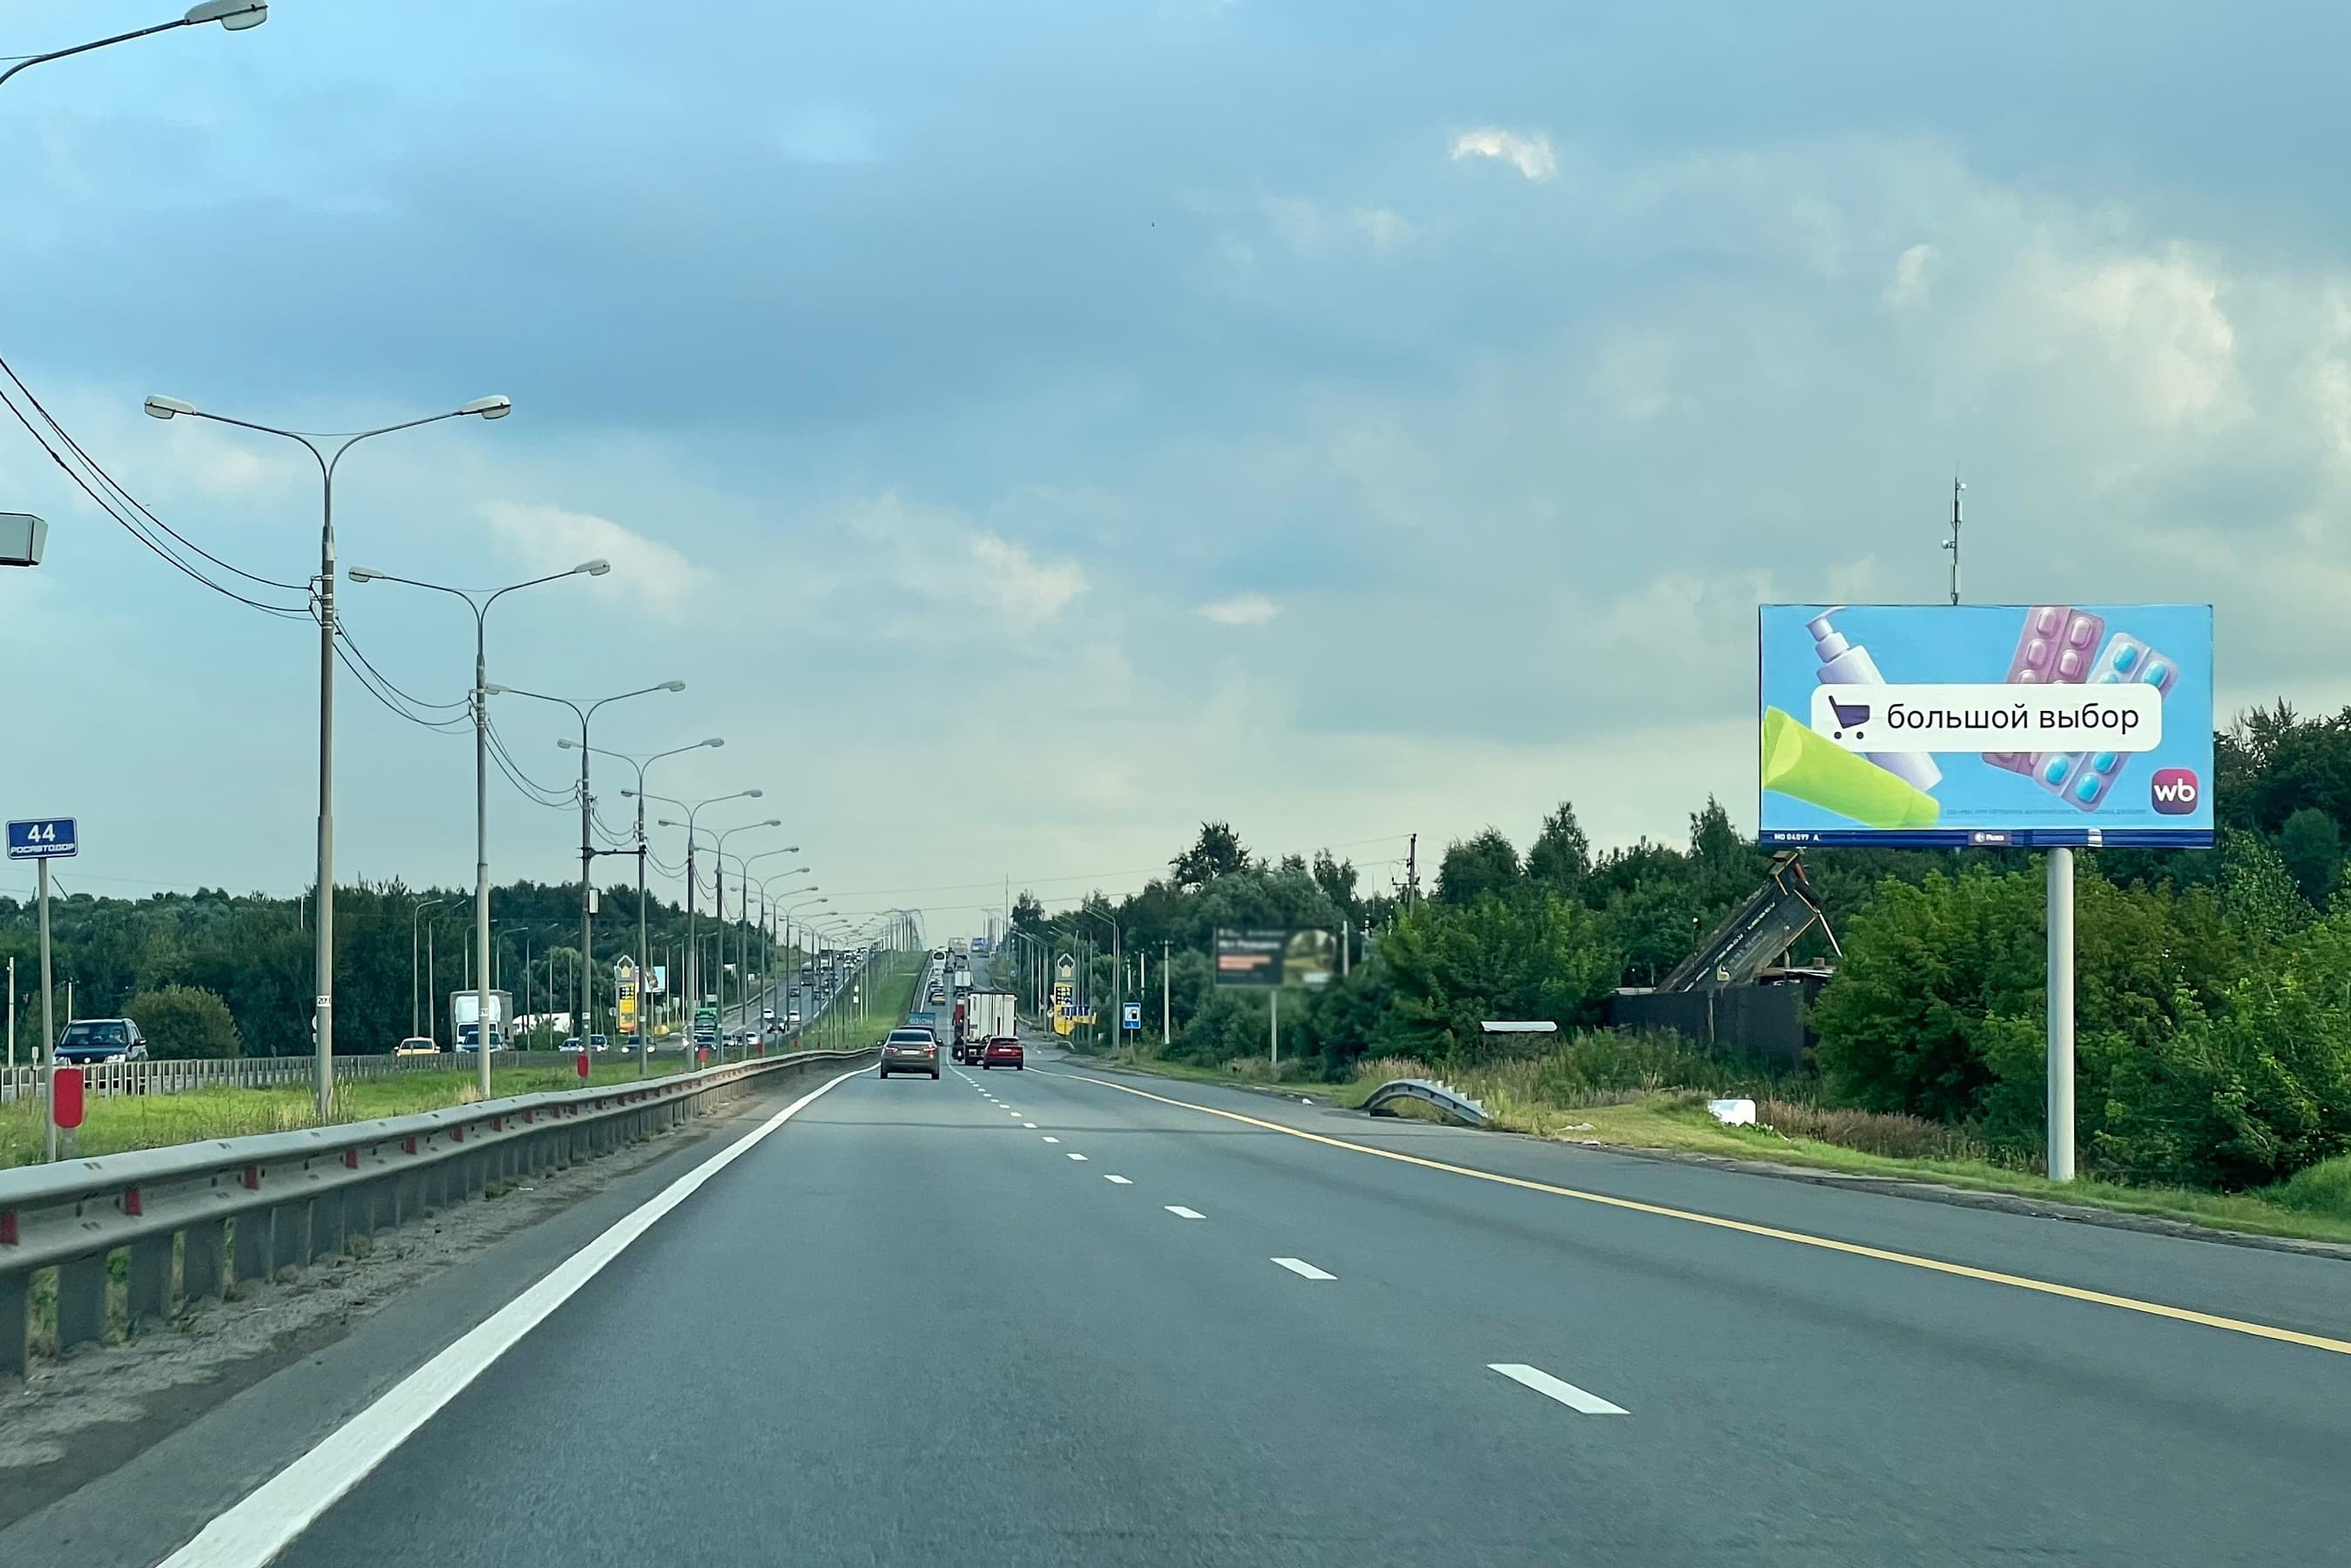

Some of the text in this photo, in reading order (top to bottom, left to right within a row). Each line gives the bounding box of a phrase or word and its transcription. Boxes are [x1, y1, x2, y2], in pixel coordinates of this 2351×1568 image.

[1887, 702, 2139, 735] большой выбор
[2152, 778, 2196, 802] wb
[27, 823, 56, 842] 44
